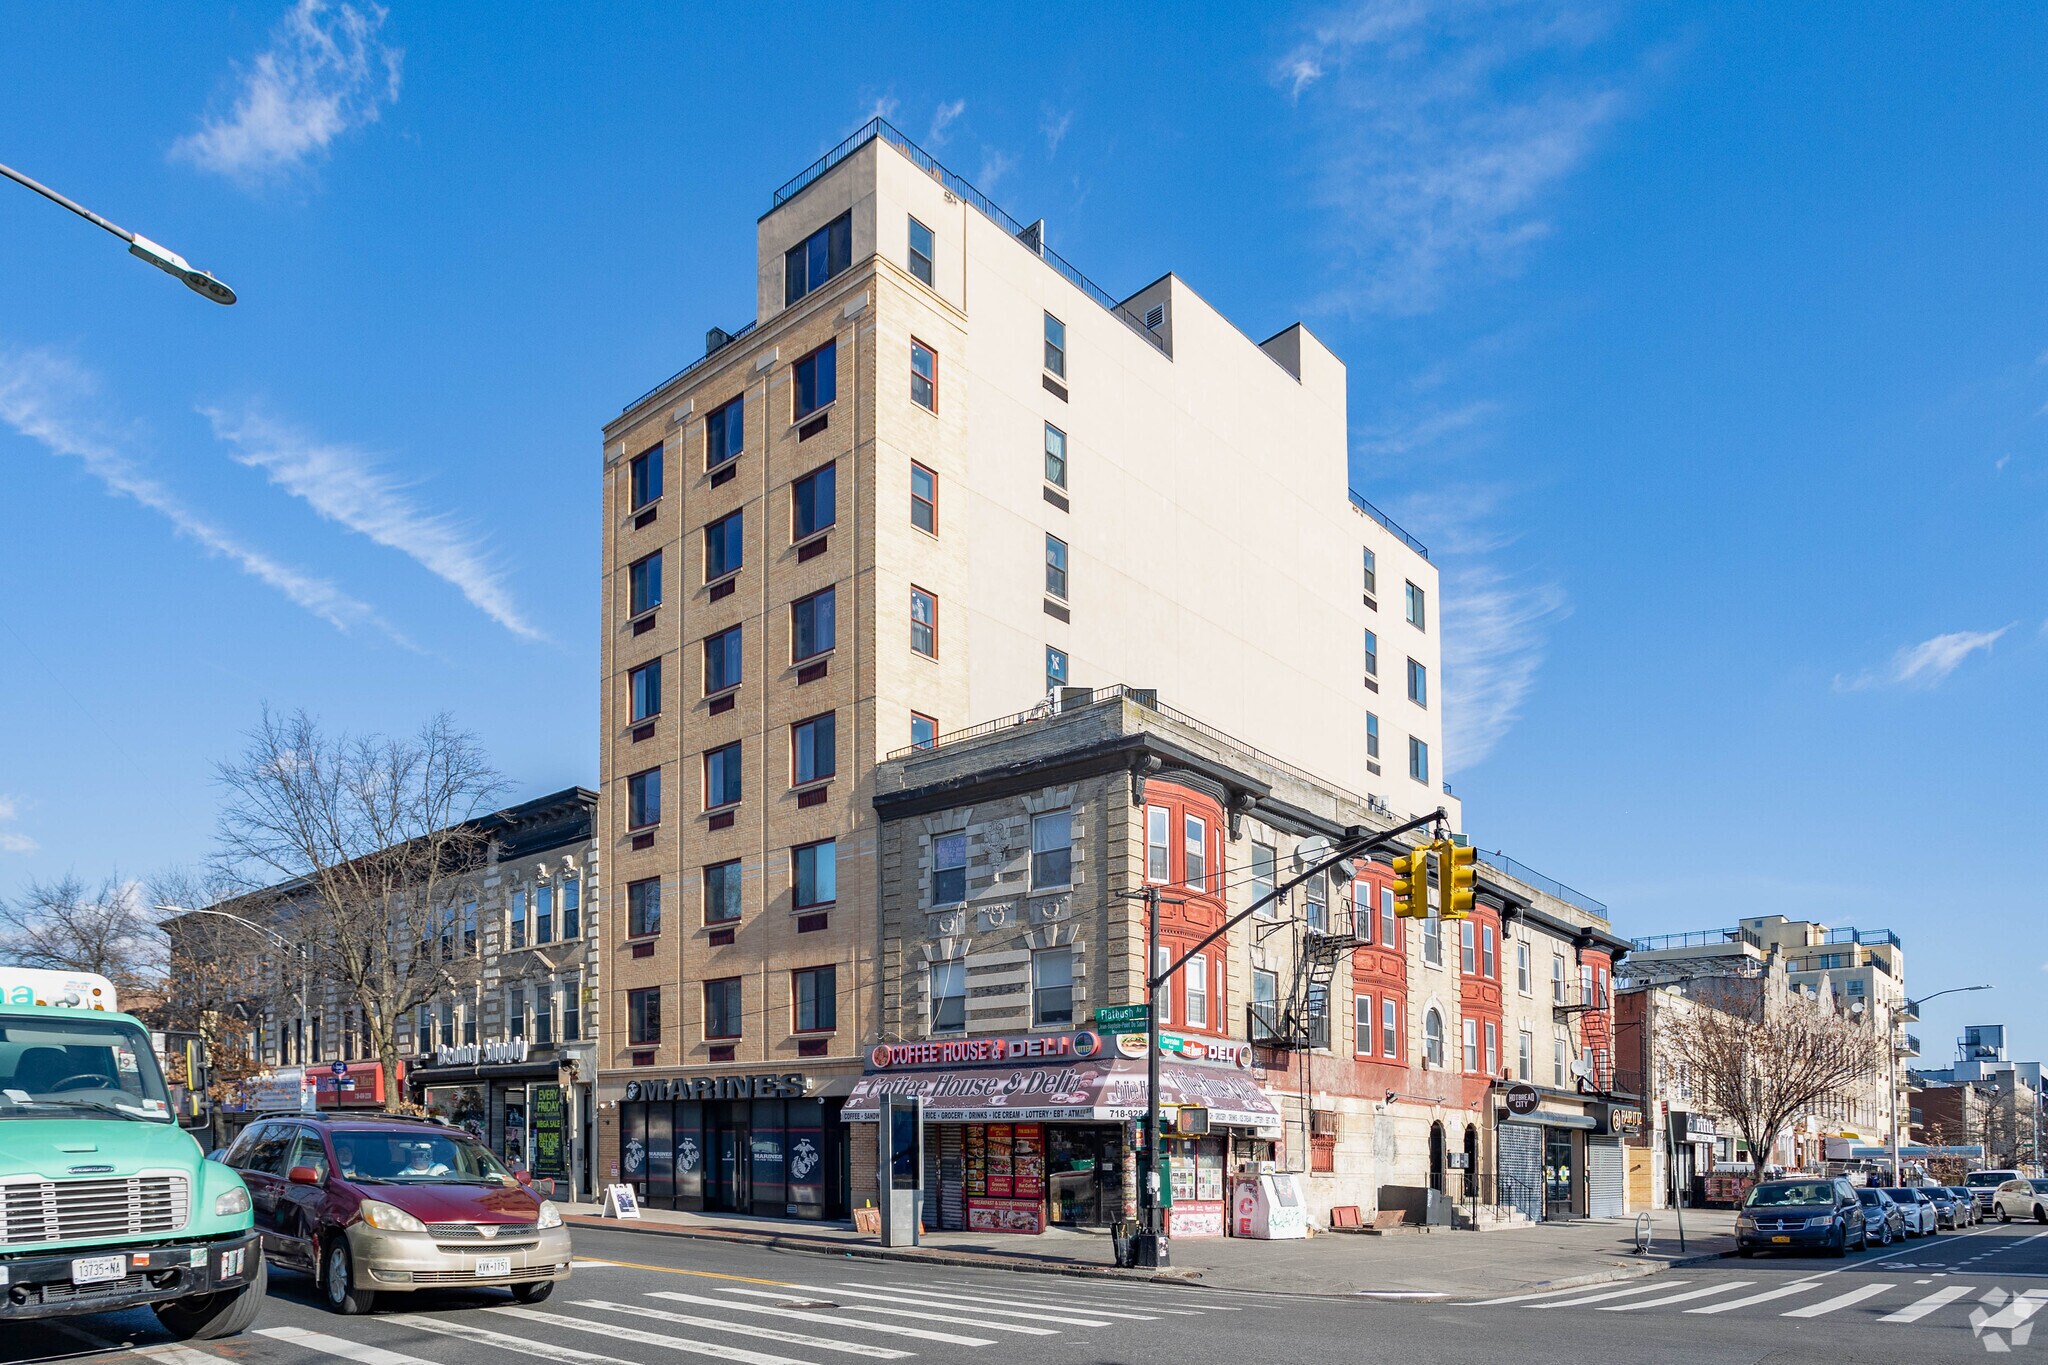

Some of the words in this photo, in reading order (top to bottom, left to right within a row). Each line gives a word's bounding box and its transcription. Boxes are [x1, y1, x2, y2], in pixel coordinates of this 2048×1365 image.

[1101, 1008, 1134, 1020] Flatbush
[437, 1043, 481, 1066] Beauty
[483, 1034, 529, 1064] Supply
[891, 1043, 941, 1065] COFFEE
[943, 1040, 992, 1062] HOUSE
[992, 1039, 1005, 1060] &
[1008, 1037, 1070, 1058] DELI
[1208, 1045, 1236, 1062] DELI
[640, 1073, 806, 1100] MARINES
[866, 1076, 928, 1097] Coffee
[930, 1075, 998, 1098] House
[1002, 1071, 1022, 1096] &
[538, 1089, 558, 1100] EVERY
[1508, 1092, 1534, 1102] HOTBREAD
[537, 1102, 560, 1112] FRIDAY
[992, 1111, 1001, 1119] ICE
[1002, 1111, 1020, 1119] CREAM
[1025, 1110, 1049, 1118] LOTTERY
[1053, 1110, 1064, 1118] EBT
[536, 1120, 549, 1128] MEGA
[549, 1120, 560, 1128] SALE
[538, 1140, 548, 1148] GET
[549, 1140, 559, 1148] ONE
[543, 1148, 554, 1156] FREE
[80, 1261, 120, 1277] 13735-NA
